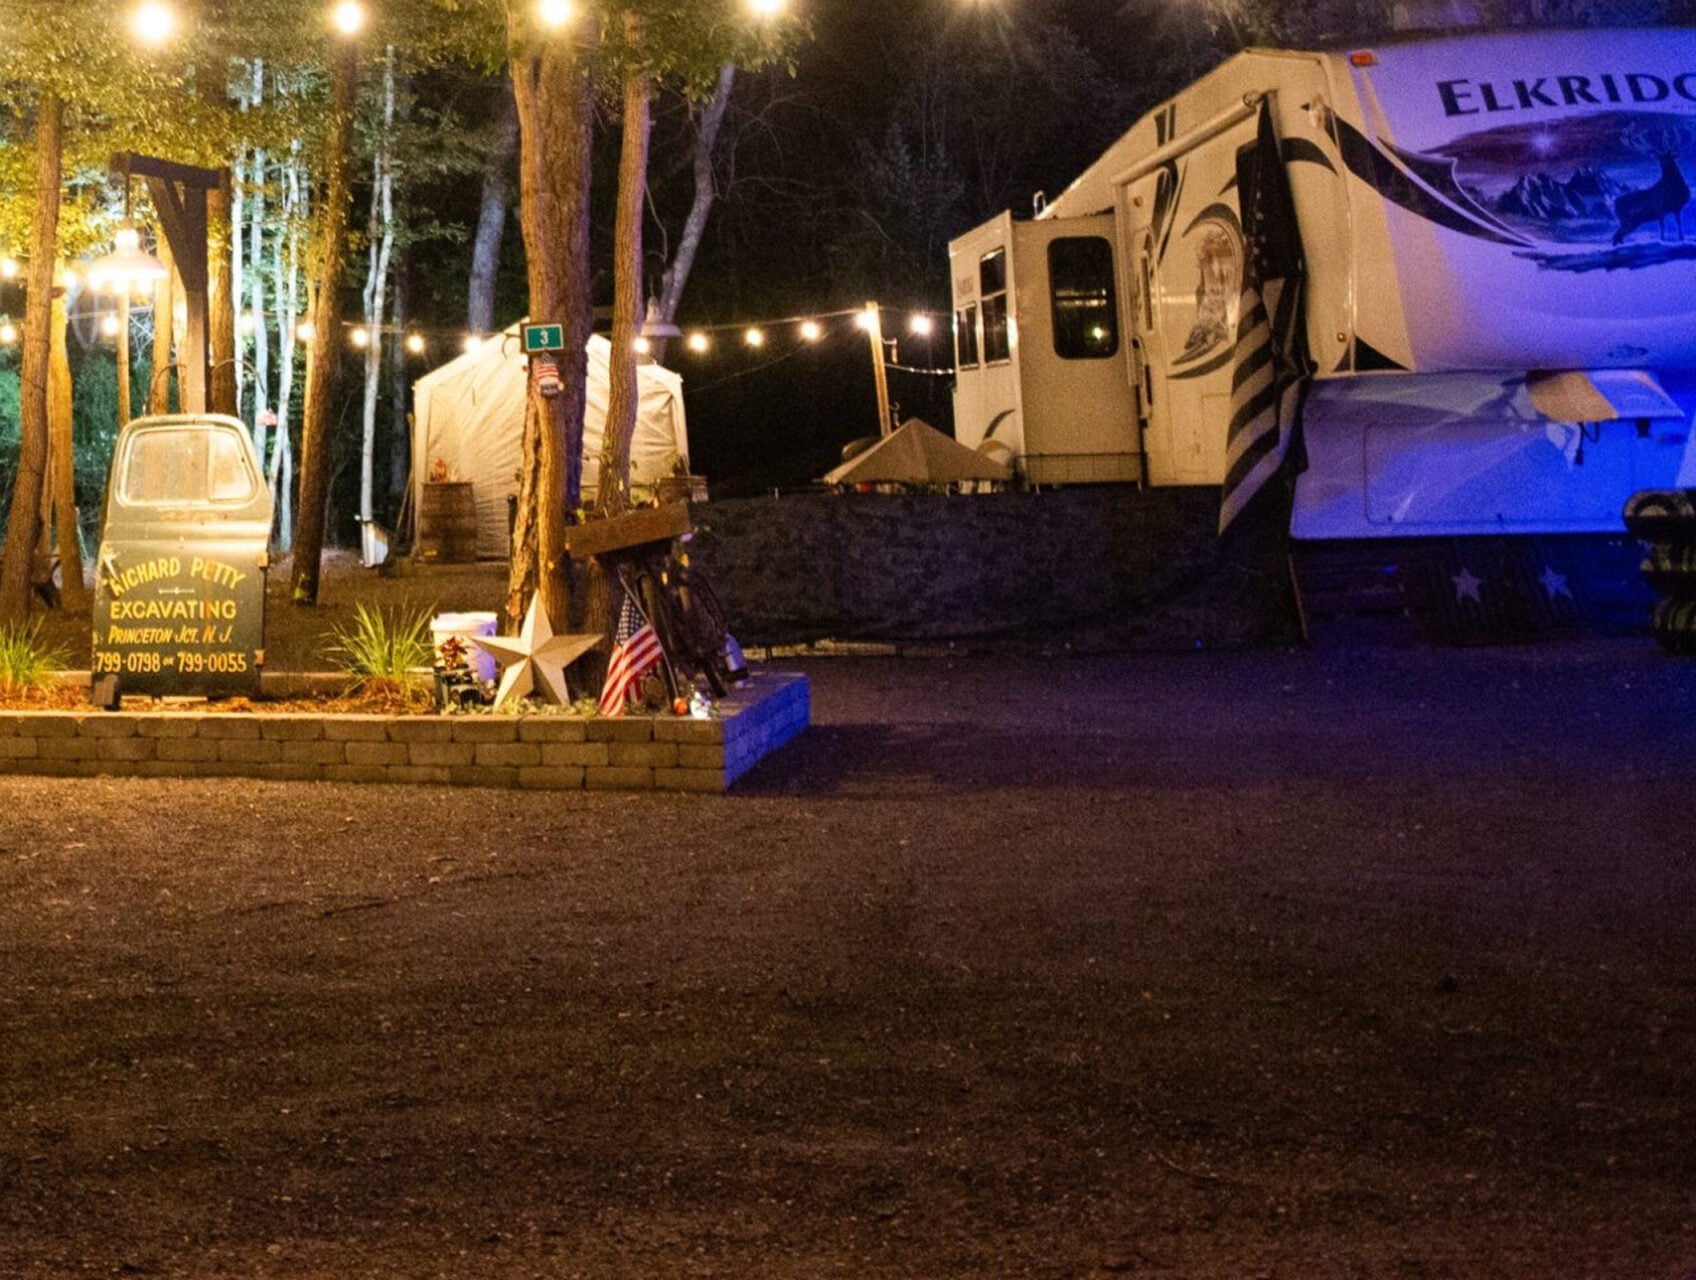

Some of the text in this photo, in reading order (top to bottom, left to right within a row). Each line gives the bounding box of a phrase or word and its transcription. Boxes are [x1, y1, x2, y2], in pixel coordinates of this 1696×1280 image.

[540, 330, 549, 344] 3
[109, 557, 246, 597] RICHARD PETTY
[110, 601, 236, 619] EXCAVATING
[109, 625, 172, 644] PRINCETON
[96, 652, 161, 673] 799-0798
[177, 652, 247, 672] 799-0055
